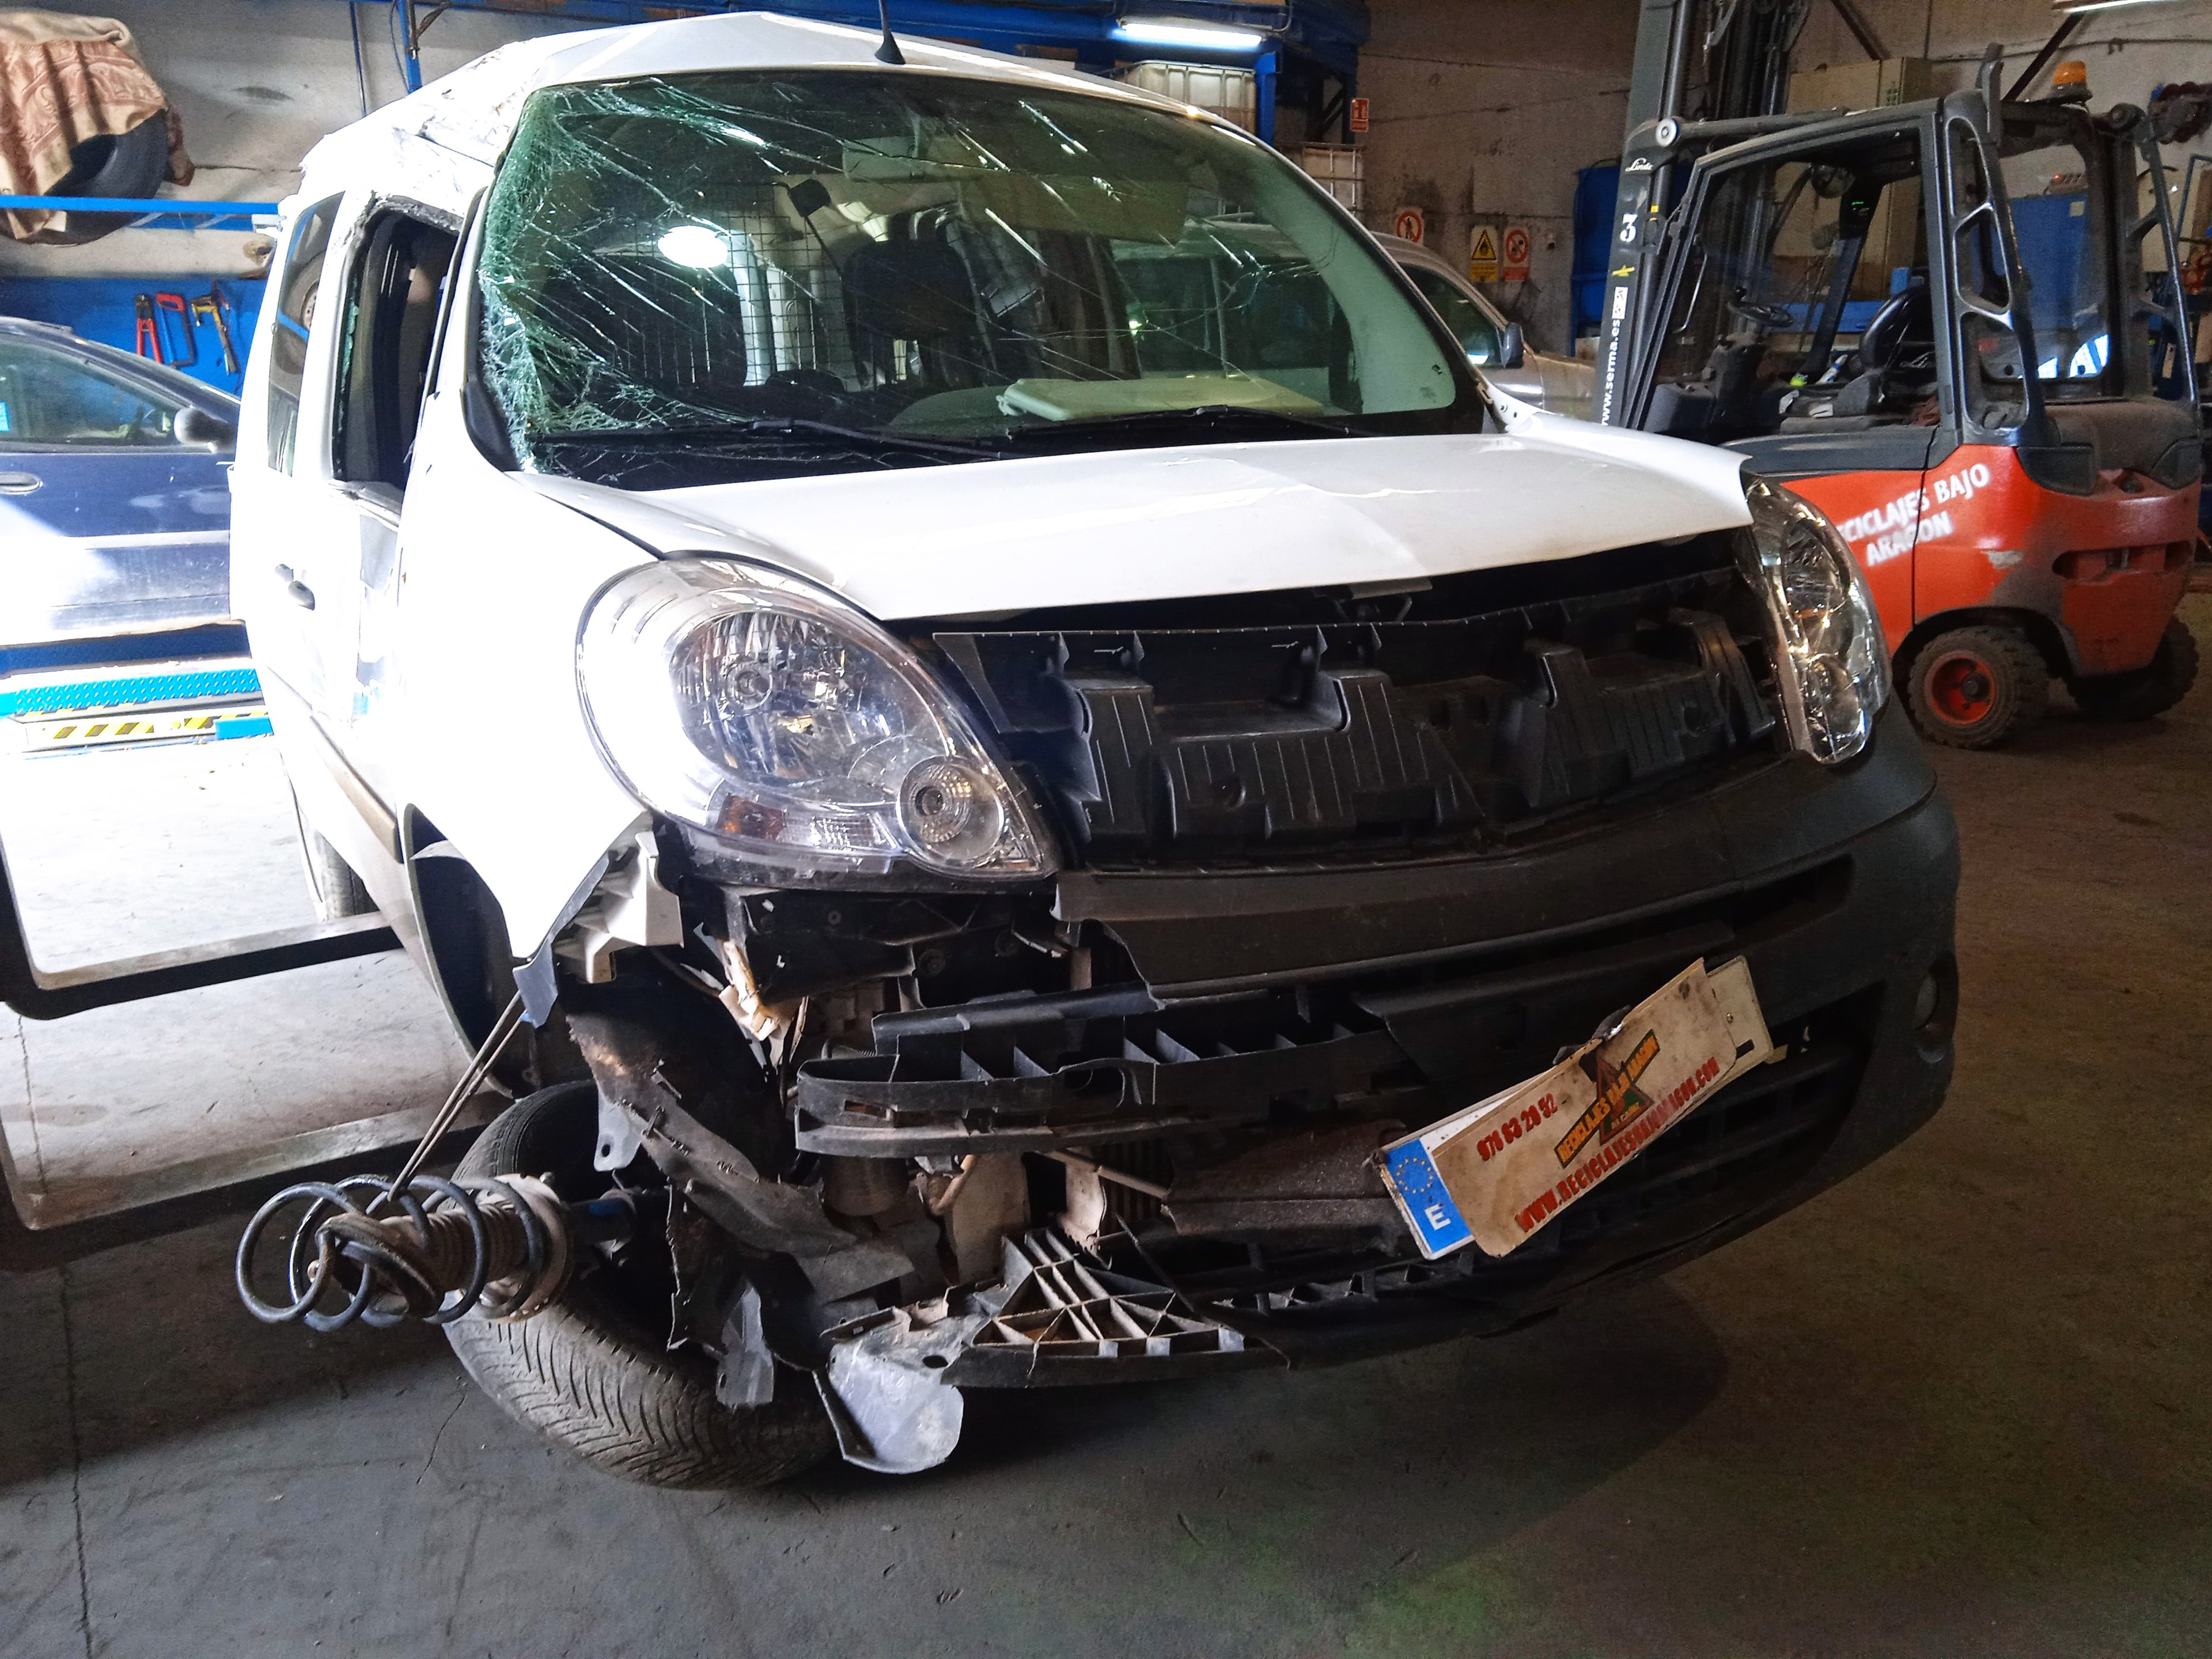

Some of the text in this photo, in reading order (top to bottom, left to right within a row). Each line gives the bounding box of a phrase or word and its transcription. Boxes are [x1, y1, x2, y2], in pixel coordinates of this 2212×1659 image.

[1624, 157, 1654, 172] Linde
[1620, 213, 1638, 243] 3
[1933, 463, 1990, 504] BAJO
[1866, 510, 1954, 567] ARAGON
[1521, 1104, 1541, 1132] 20
[1537, 1092, 1558, 1118] 52
[1556, 1097, 1611, 1162] RECICLAJES
[1424, 1203, 1452, 1231] E
